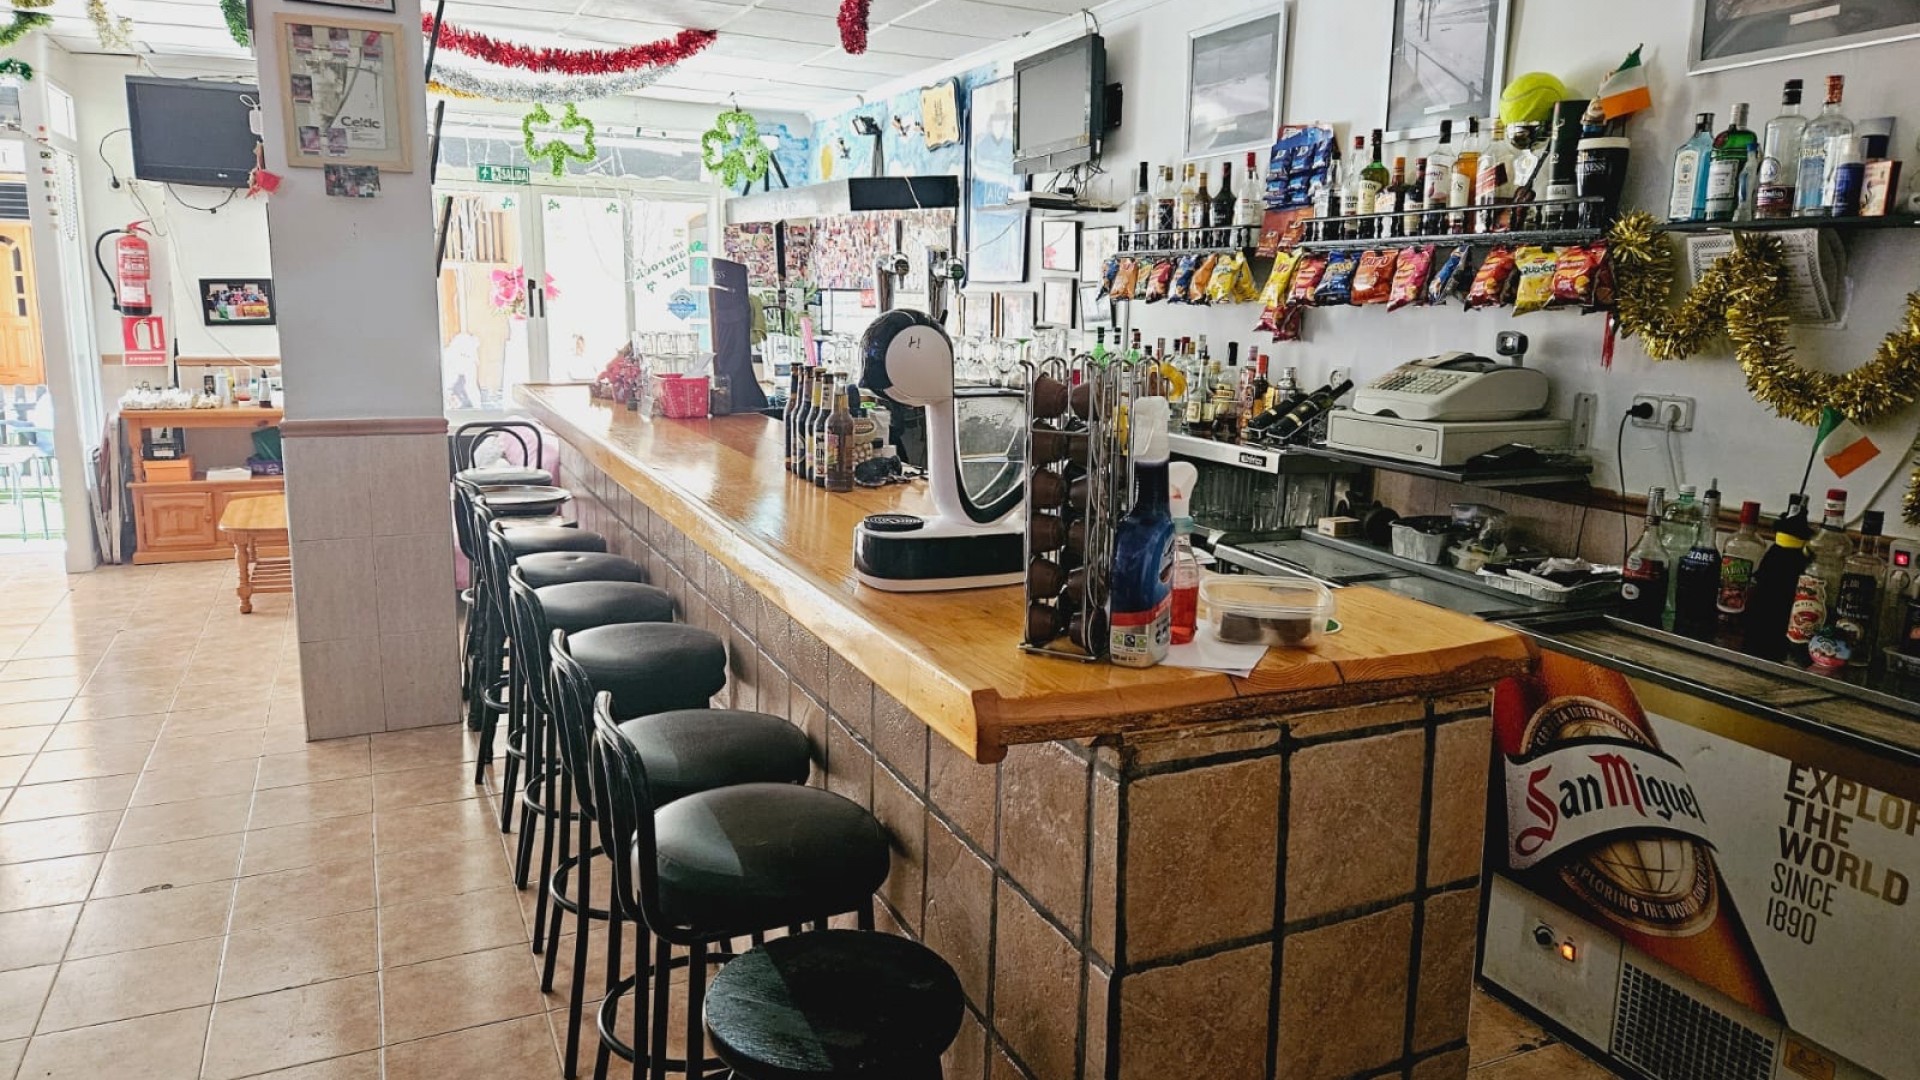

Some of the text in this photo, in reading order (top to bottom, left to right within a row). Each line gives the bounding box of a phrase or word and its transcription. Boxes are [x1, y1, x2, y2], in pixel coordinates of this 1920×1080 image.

[1515, 753, 1708, 857] San Miguel
[1784, 793, 1854, 849] THE
[1771, 862, 1838, 918] SINCE
[1779, 826, 1910, 907] WORLD
[1641, 901, 1666, 919] THE
[1765, 896, 1818, 946] 1890
